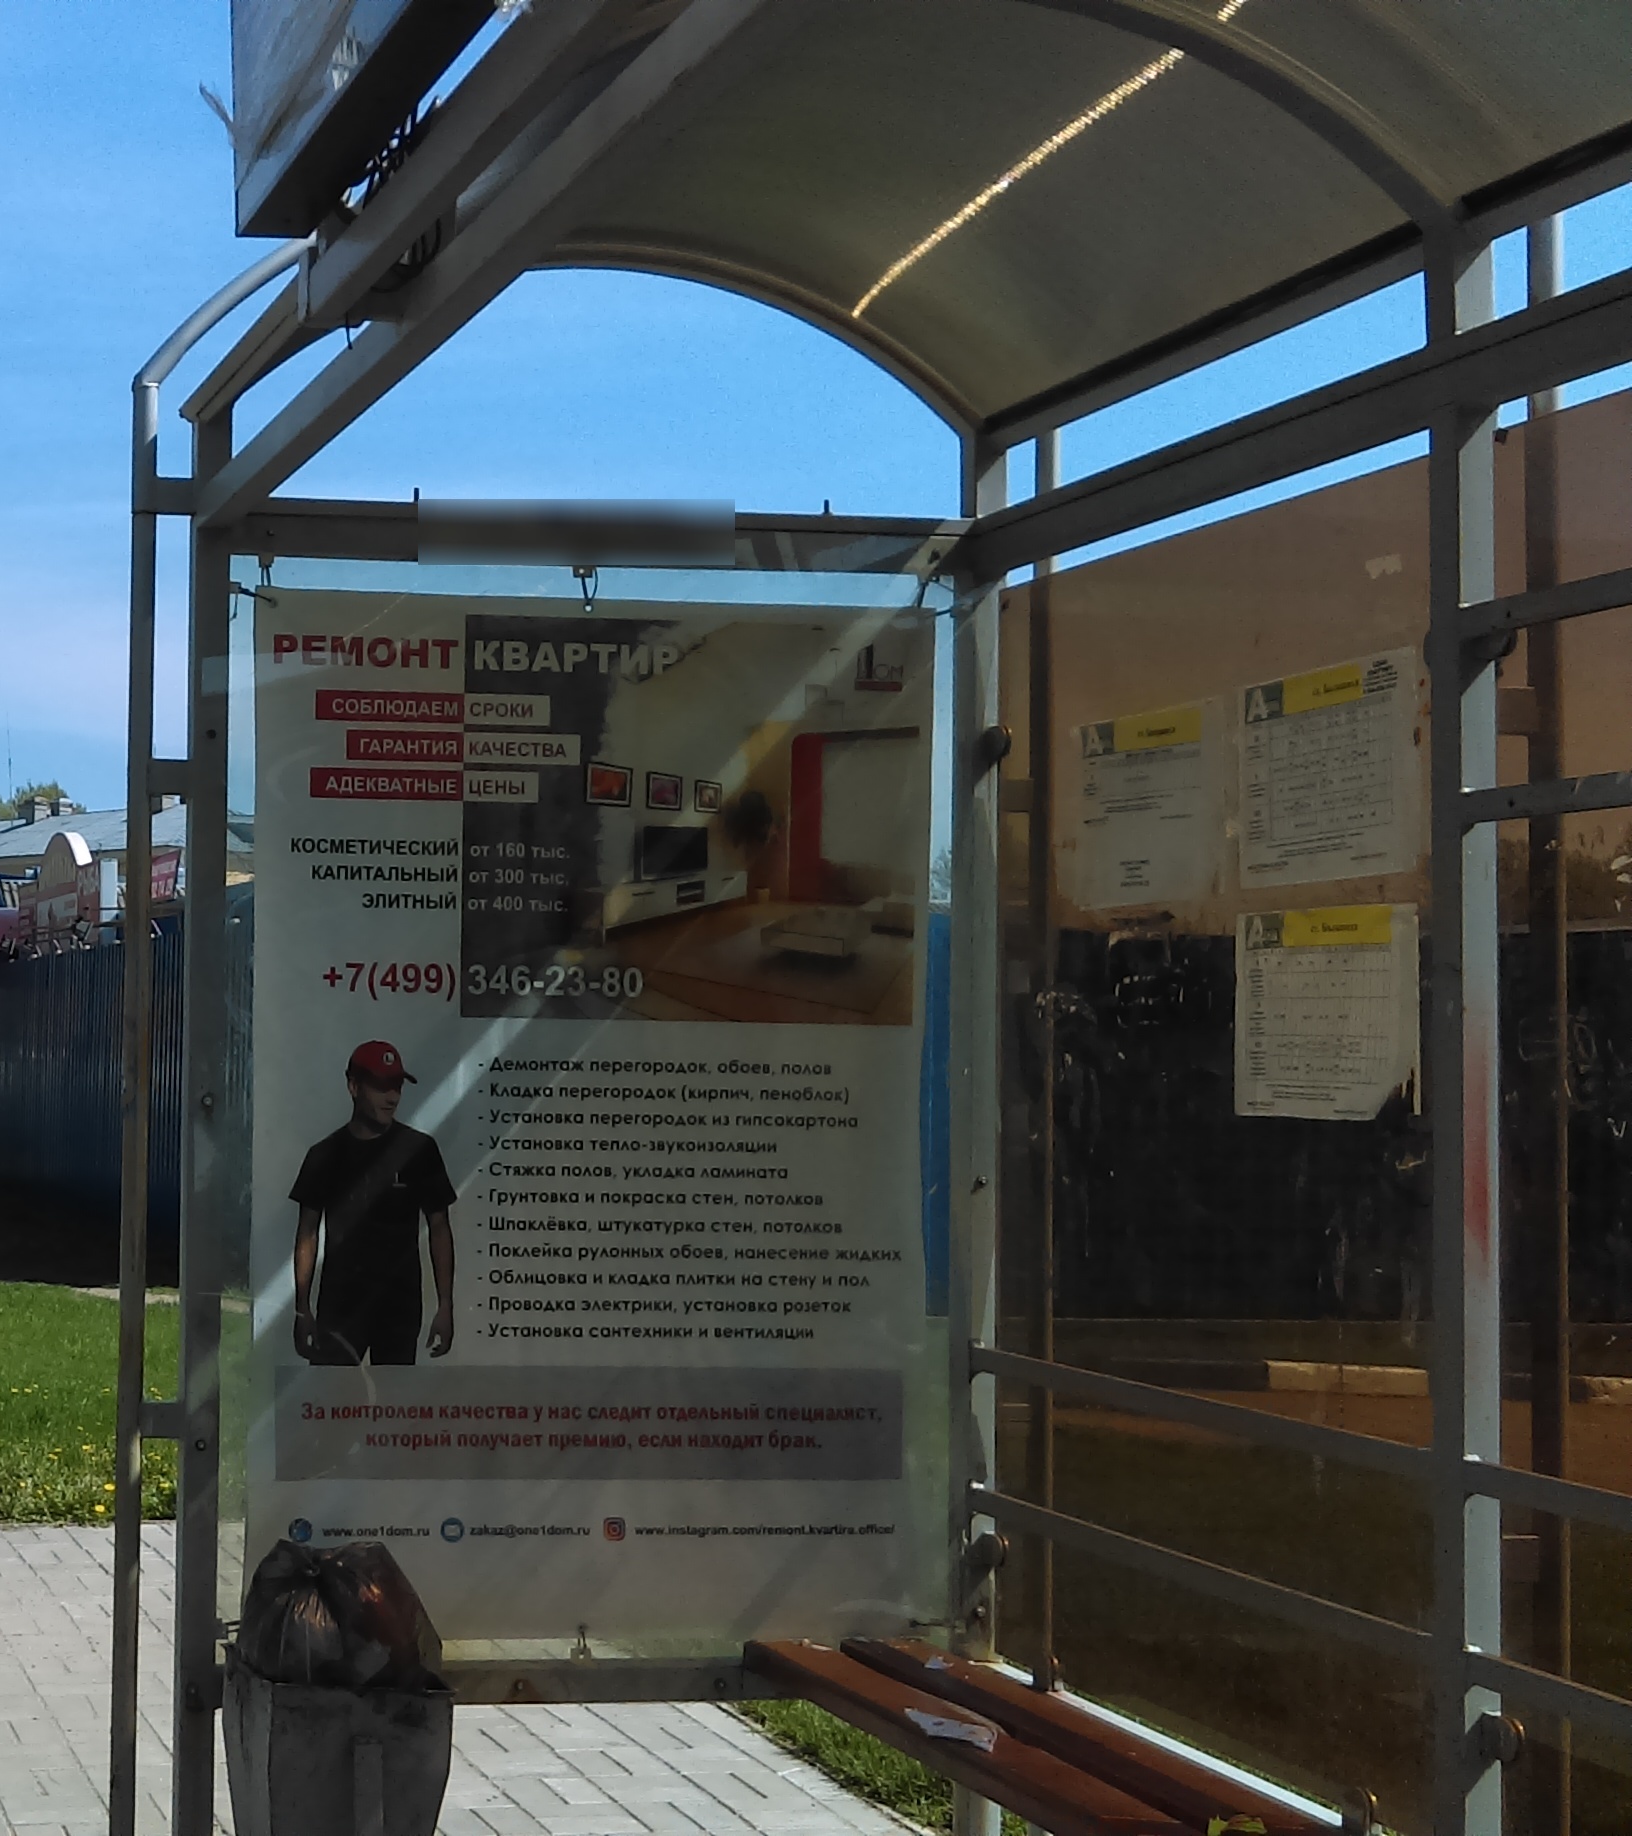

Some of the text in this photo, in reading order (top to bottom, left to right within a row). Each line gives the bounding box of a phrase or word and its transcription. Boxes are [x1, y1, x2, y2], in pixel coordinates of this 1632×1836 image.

[272, 633, 680, 674] РЕМОНТ КВАРТИР
[331, 698, 534, 719] СОБЛЮДАЕМ СРОКИ
[359, 738, 567, 758] ГАРАНТИЯ КАЧЕСТВА
[325, 777, 526, 798] АДЕКВАТНЫЕ ЦЕНЫ
[290, 838, 571, 859] КОСМЕТИЧЕСКИЙ от 160 тыс.
[311, 864, 569, 886] КАПИТАЛЬНЫЙ от 300 тыс.
[361, 892, 568, 913] ЭЛИТНЫЙ от 400 тыс.
[322, 962, 644, 1001] +7(499) 346-23-80
[489, 1057, 832, 1076] Демонтаж перегородок, обоев, полов
[490, 1083, 849, 1105] Кладка перегородок (кирпич, пеноблок)
[489, 1109, 858, 1131] Установка перегородок из гипсокартона
[489, 1135, 777, 1154] Установка тепло-звукоизоляции
[489, 1162, 788, 1180] Стяжка полов, укладка ламината
[489, 1188, 824, 1207] Грунтовка и покраска стен, потолков
[488, 1215, 843, 1235] Шпаклёвка, штукатурка стен, потолков
[488, 1242, 902, 1262] Поклейка рулонных обоев, нанесение жидких
[488, 1270, 870, 1289] Облицовка и кладка плитки на стену и пол
[488, 1296, 851, 1315] Проводка электрики, установка розеток
[488, 1322, 814, 1340] Установка сантехники и вентиляции
[301, 1402, 882, 1423] За контролем качества у нас следит отдельный специалист,
[366, 1430, 822, 1450] который получает премию, если находит брак.
[322, 1525, 430, 1537] www.one1dom.ru
[469, 1525, 591, 1538] zakaz@one1dom.ru
